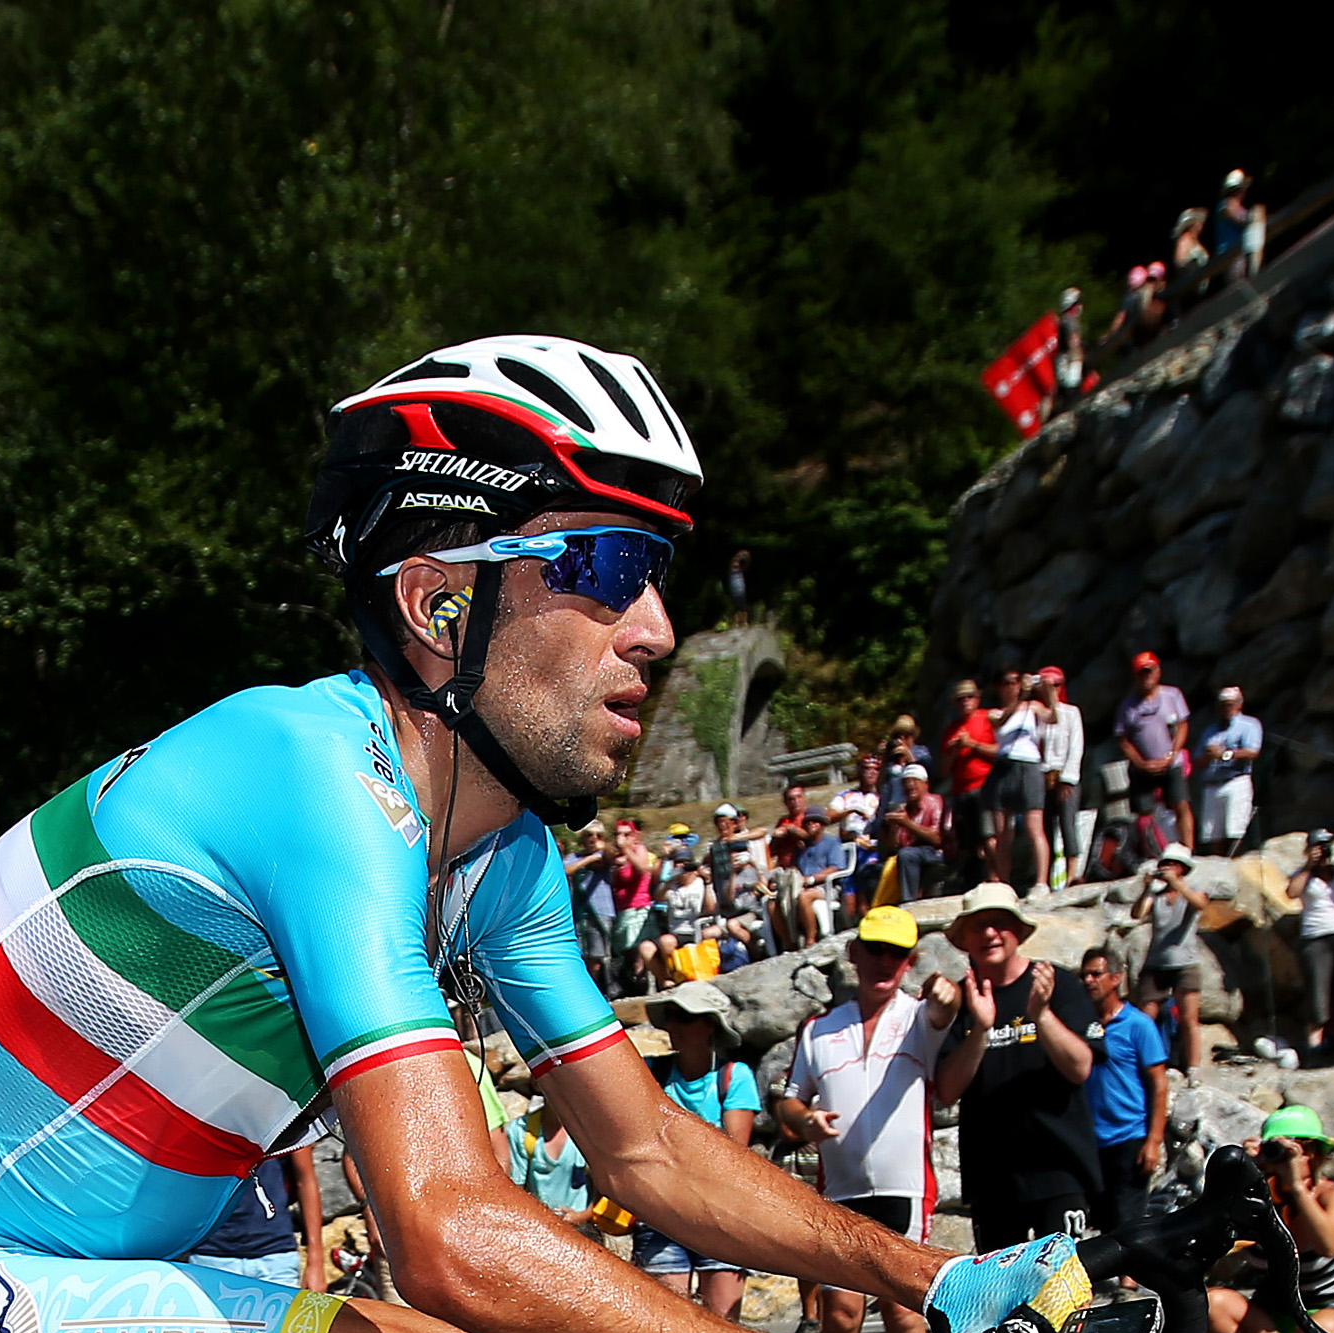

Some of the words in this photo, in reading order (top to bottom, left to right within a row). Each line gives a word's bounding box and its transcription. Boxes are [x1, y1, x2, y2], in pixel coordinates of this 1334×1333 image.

[395, 451, 529, 492] SPECIALIZED
[400, 492, 491, 513] ASTANA
[364, 738, 395, 784] air
